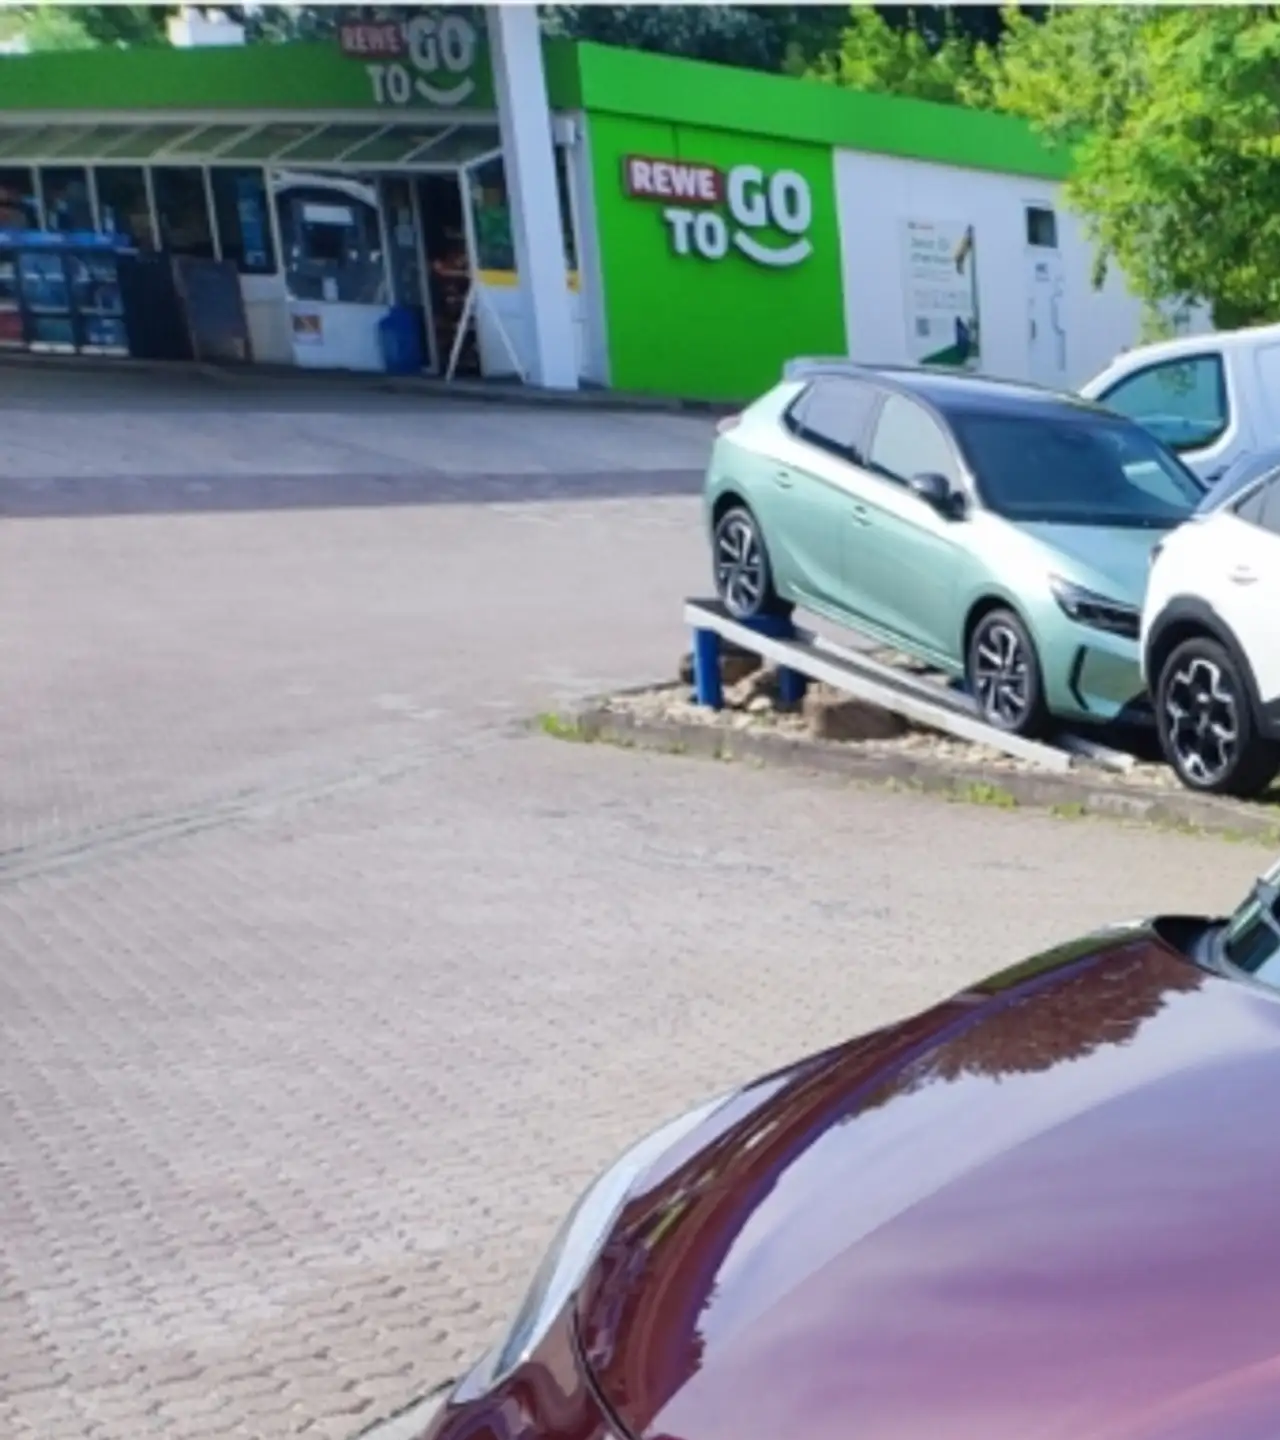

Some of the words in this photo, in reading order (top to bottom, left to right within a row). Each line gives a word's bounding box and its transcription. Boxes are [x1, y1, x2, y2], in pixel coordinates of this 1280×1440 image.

[341, 23, 401, 53] REWE
[365, 63, 410, 104] TO
[408, 14, 477, 72] GO
[630, 159, 718, 201] REWE
[663, 207, 729, 260] TO
[727, 163, 812, 235] GO
